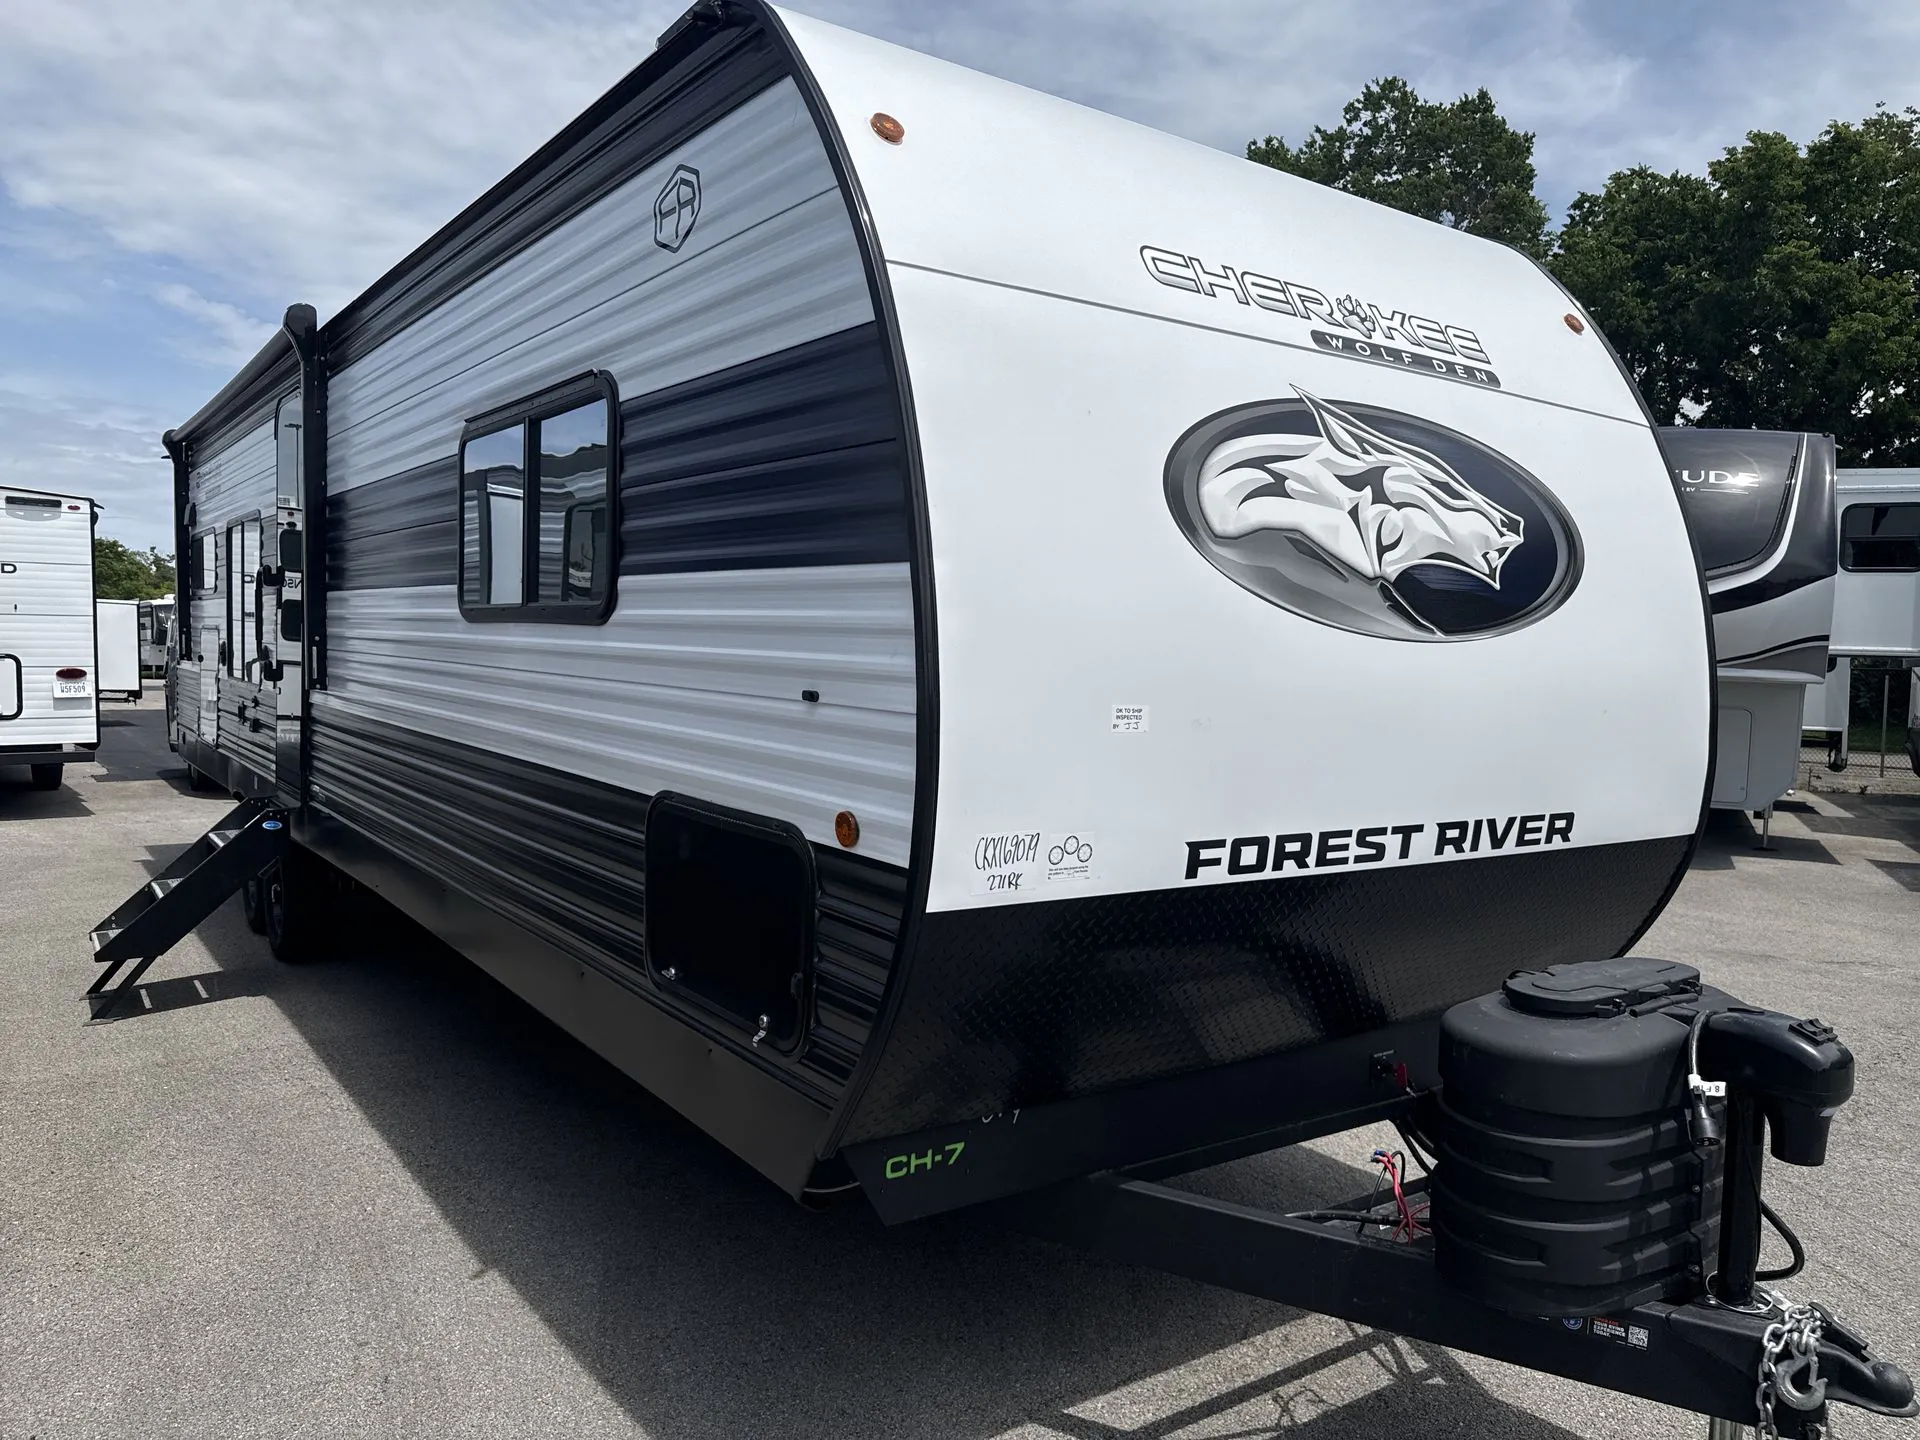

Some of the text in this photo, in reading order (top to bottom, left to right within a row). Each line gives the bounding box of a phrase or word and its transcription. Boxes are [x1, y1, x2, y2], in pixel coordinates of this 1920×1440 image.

[1325, 335, 1489, 383] WOLF DEN
[1675, 469, 1760, 487] UDE
[1184, 811, 1576, 881] FOREST RIVER
[885, 1141, 966, 1180] CH-7
